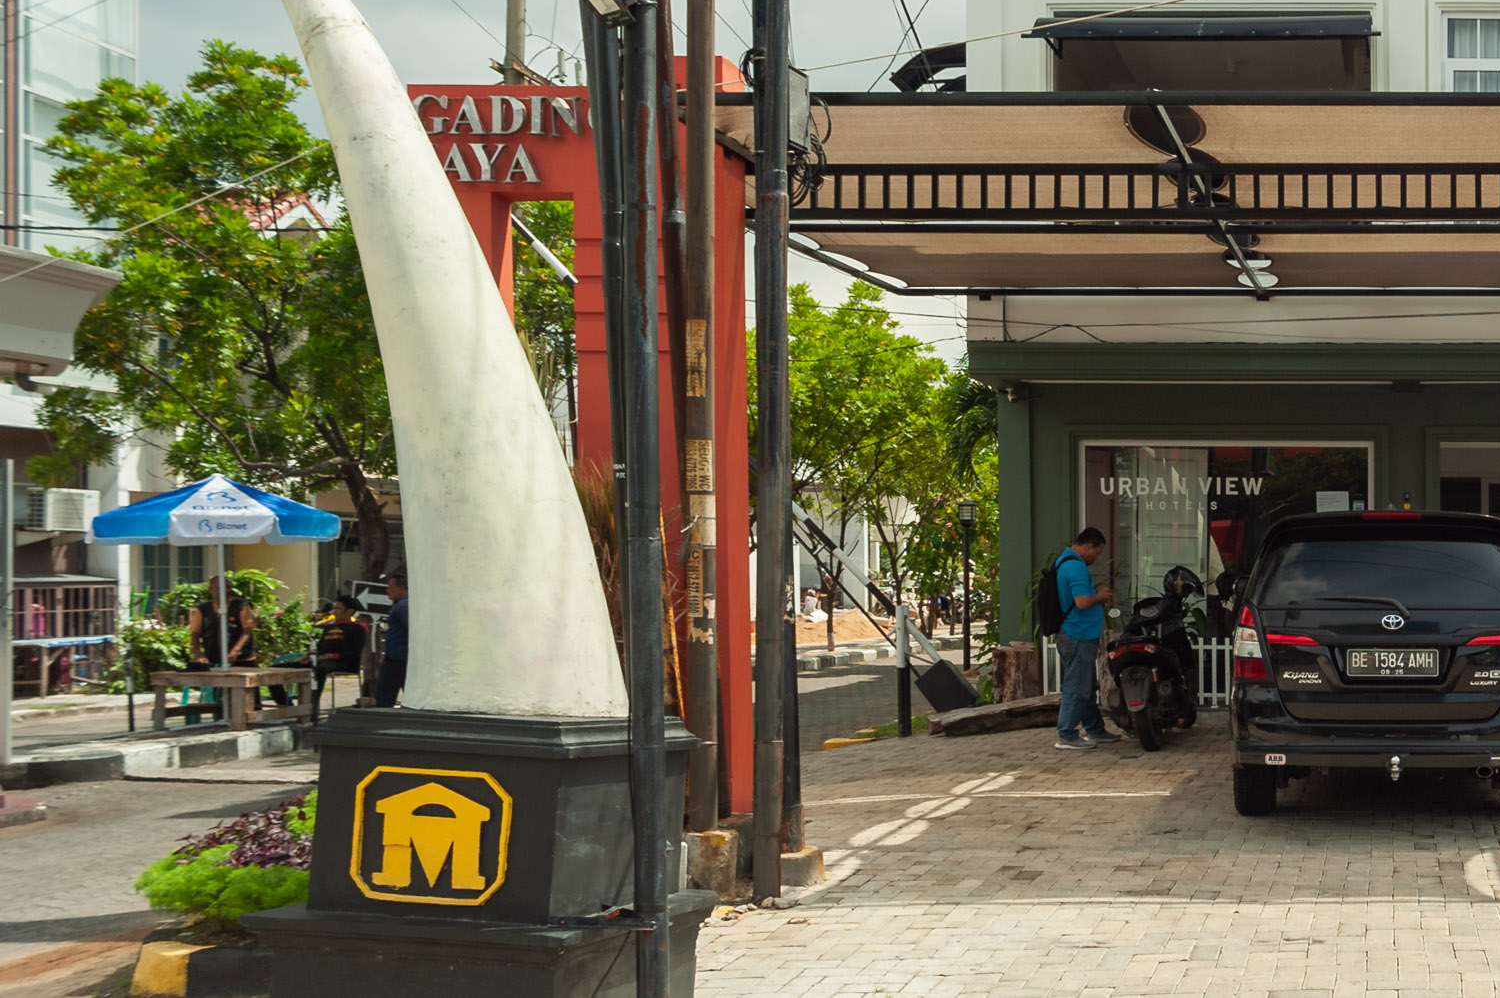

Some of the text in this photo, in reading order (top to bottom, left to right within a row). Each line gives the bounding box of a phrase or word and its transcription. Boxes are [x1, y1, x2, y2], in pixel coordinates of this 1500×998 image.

[413, 94, 593, 137] GADIN
[443, 142, 542, 184] AYA
[1100, 476, 1263, 498] URBAN VIEW
[1146, 501, 1218, 511] HOTELS
[216, 522, 247, 530] Biznet
[1352, 652, 1433, 668] BE 1584 AMH
